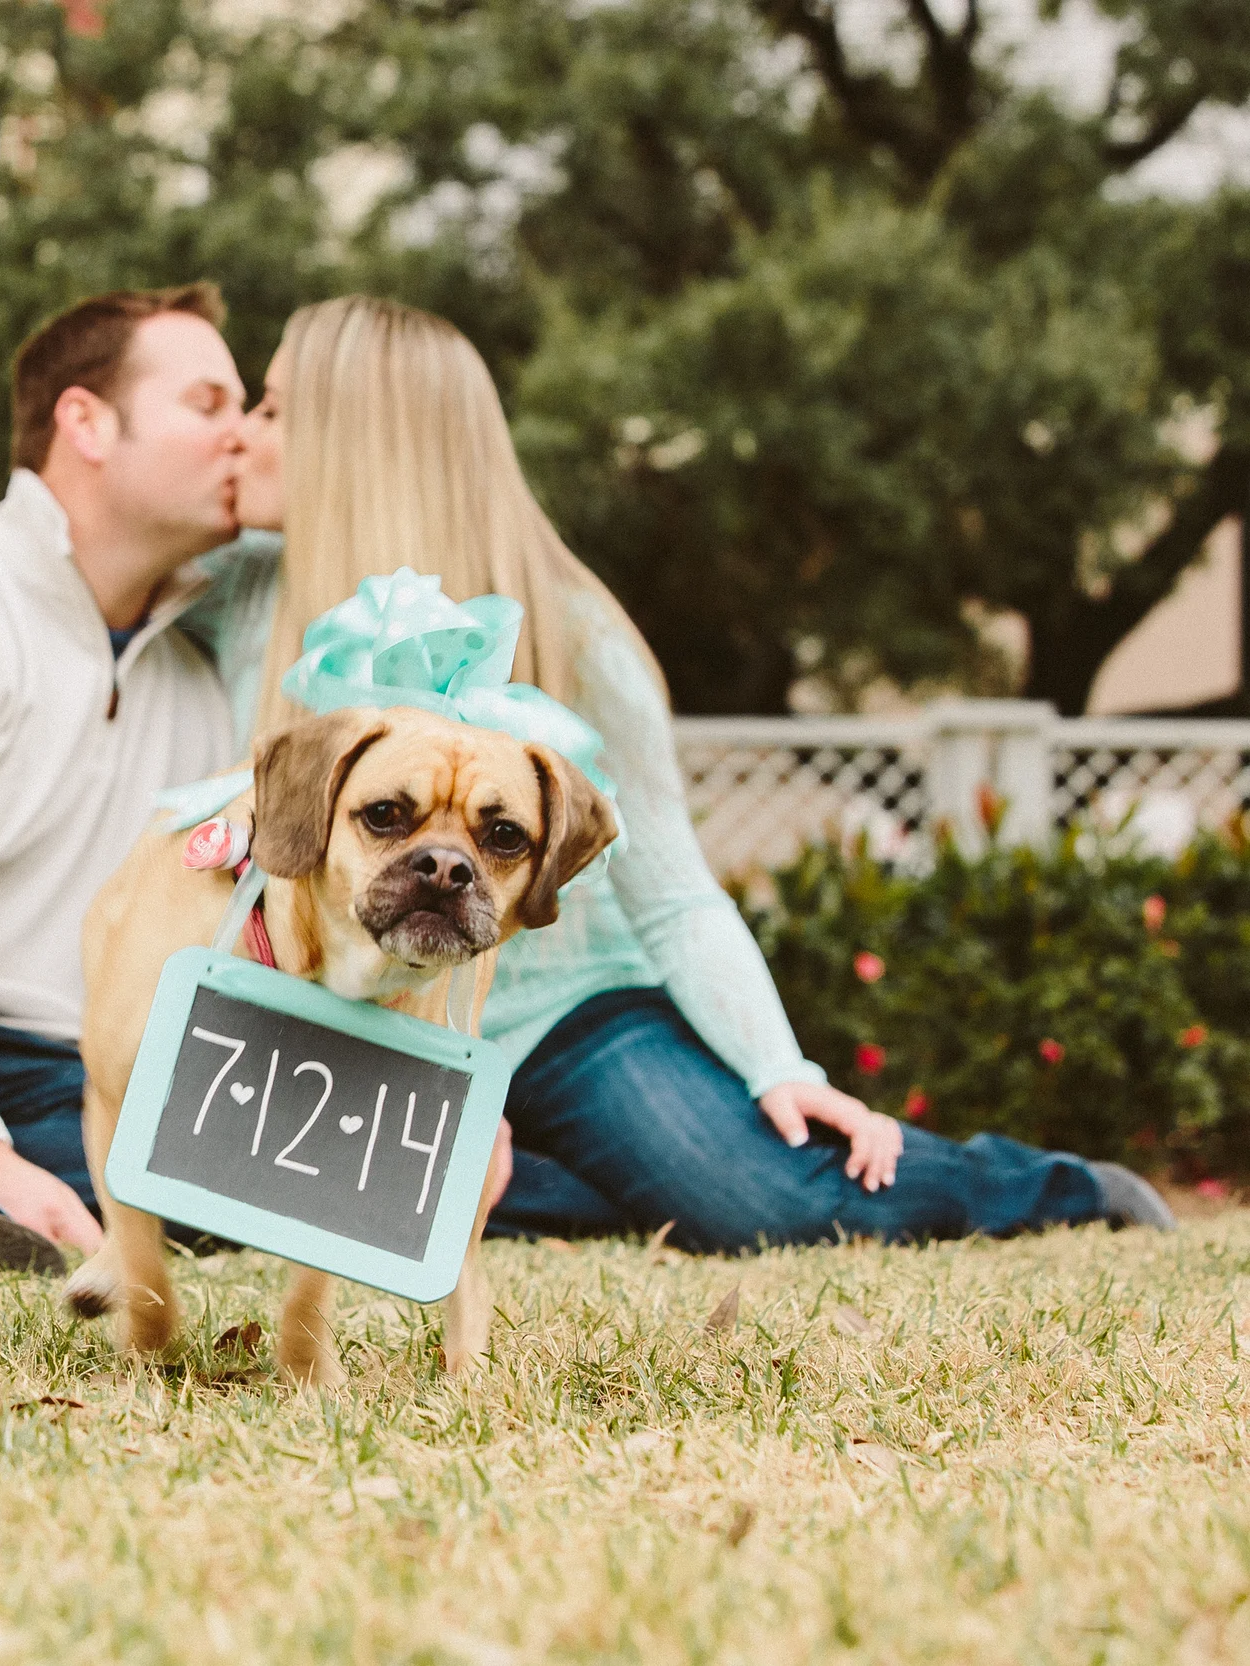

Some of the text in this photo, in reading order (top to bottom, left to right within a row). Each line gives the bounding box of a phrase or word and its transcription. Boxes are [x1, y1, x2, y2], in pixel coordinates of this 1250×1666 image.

[191, 1026, 450, 1214] 7 12 14
